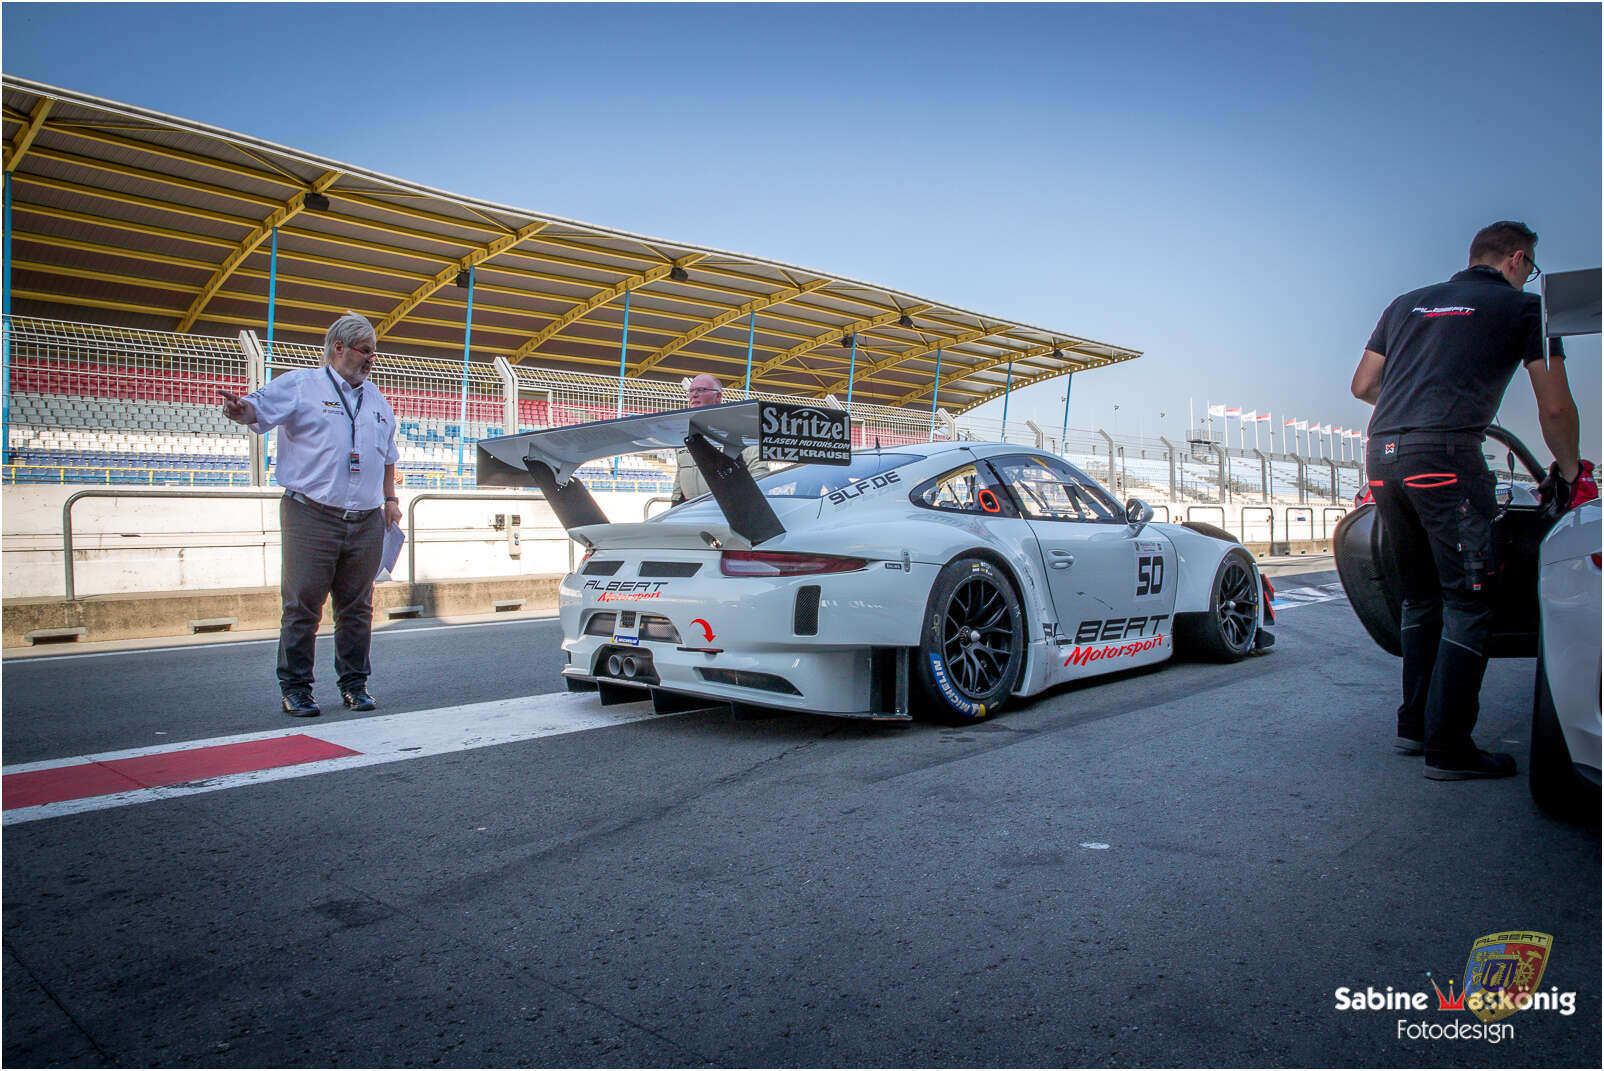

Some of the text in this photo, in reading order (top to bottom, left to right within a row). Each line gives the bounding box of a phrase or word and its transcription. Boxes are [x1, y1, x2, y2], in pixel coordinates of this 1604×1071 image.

[762, 406, 850, 441] Stritzel
[762, 446, 850, 461] KLZ KRAUSE
[763, 436, 850, 450] KLASEN MOTORS.COM
[828, 471, 902, 505] 9LF.DE
[583, 580, 669, 592] ALBERT
[1135, 555, 1164, 597] 50
[597, 591, 662, 603] Motorsport
[1063, 633, 1164, 668] Motorsport
[933, 660, 971, 713] MICHELIN
